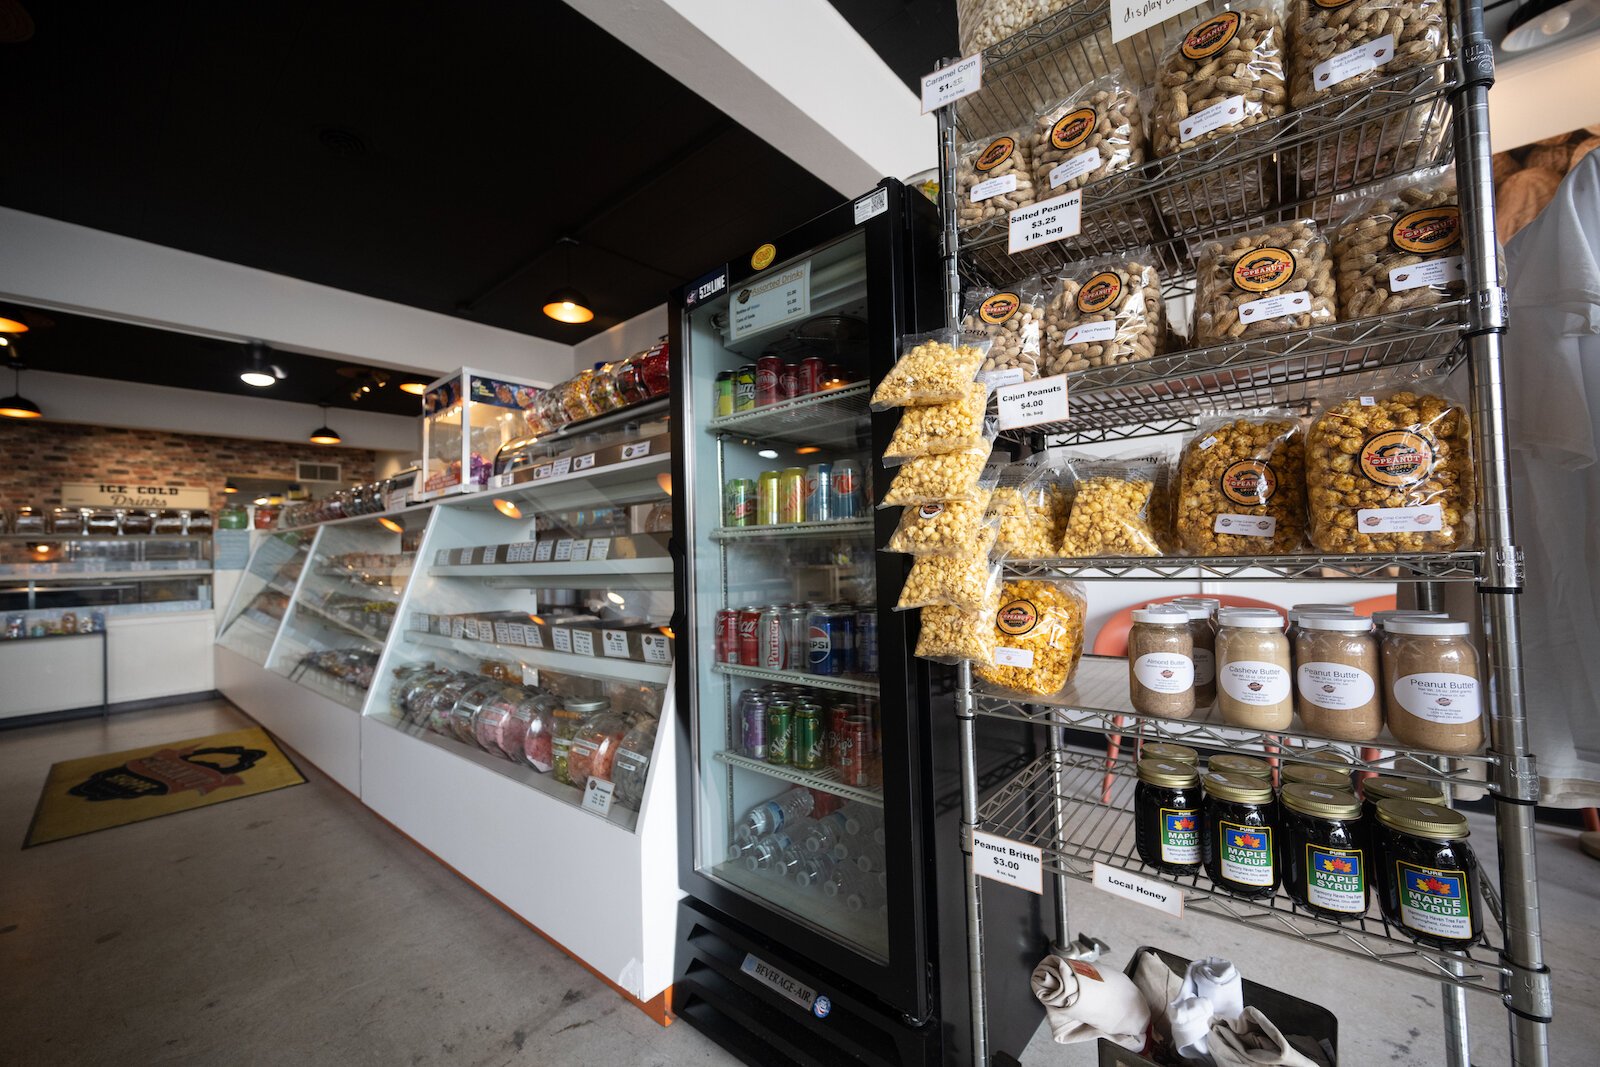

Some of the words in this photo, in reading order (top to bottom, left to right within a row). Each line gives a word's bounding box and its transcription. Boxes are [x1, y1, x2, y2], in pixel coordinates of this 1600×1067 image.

[1123, 0, 1162, 23] display
[925, 69, 956, 87] Caramel
[957, 60, 976, 73] Corn
[1011, 210, 1039, 224] Salted
[1042, 198, 1079, 216] Peanuts
[1031, 216, 1056, 229] $3.25
[1413, 220, 1455, 235] PEANUT
[1032, 231, 1043, 240] lb.
[1046, 226, 1063, 237] bag
[1250, 264, 1284, 276] PEANUT
[751, 277, 780, 294] Assorted
[782, 270, 803, 283] Drinks
[1002, 393, 1025, 402] Cajun
[1027, 386, 1061, 397] Peanuts
[1021, 400, 1043, 410] $4.00
[1380, 455, 1420, 464] PEANUT
[99, 485, 127, 493] ICE
[138, 486, 179, 495] COLD
[111, 495, 168, 507] Drinks
[768, 620, 779, 666] Partner
[1229, 666, 1258, 674] Cashew
[1304, 667, 1331, 677] Peanut
[1333, 671, 1360, 679] Butter
[1410, 678, 1447, 689] Peanut
[1449, 681, 1474, 690] Butter
[974, 839, 1006, 854] Peanut
[1009, 847, 1040, 864] Brittle
[1228, 847, 1267, 859] MAPLE
[993, 857, 1020, 871] $3.00
[1228, 854, 1267, 866] SYRUP
[1316, 872, 1359, 884] MAPLE
[1108, 876, 1133, 891] Local
[1136, 886, 1167, 902] Honey
[1317, 880, 1359, 892] SYRUP
[1408, 891, 1461, 908] MAPLE
[1410, 899, 1461, 915] SYRUP
[755, 963, 811, 1003] BEVERAGE-AIR
